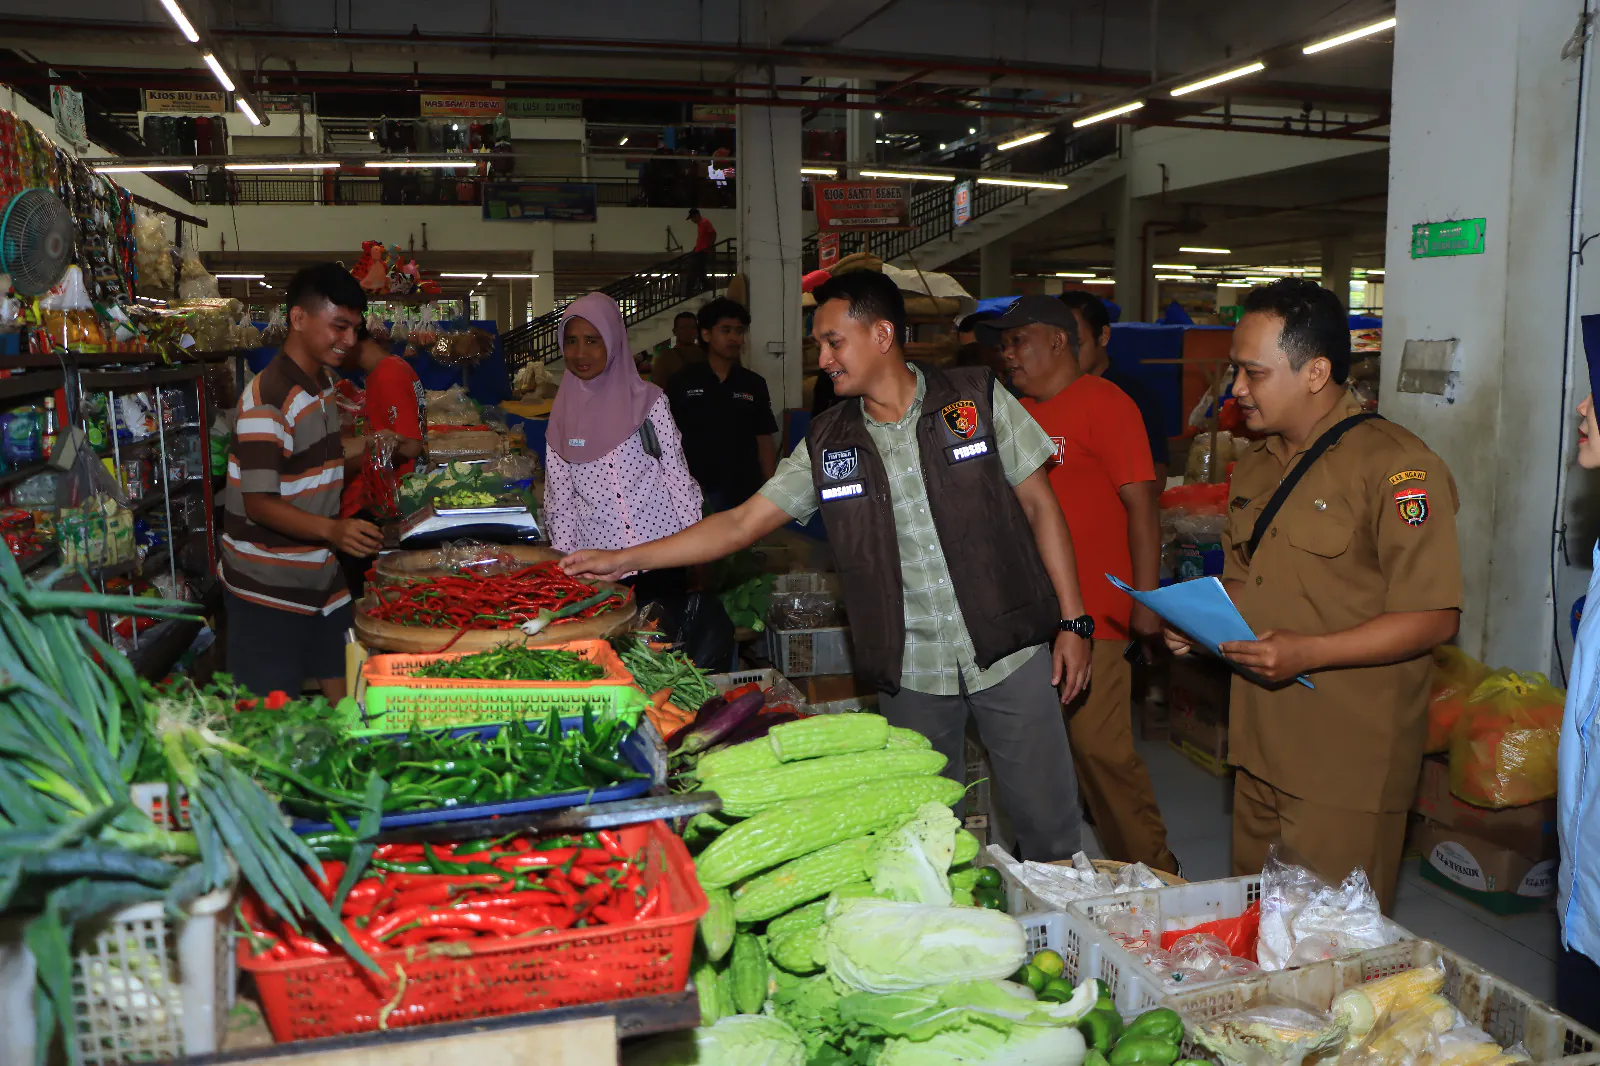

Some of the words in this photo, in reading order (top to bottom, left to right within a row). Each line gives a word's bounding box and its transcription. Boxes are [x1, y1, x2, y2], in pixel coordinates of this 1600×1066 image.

[149, 91, 176, 100] KIOS
[178, 92, 192, 100] BU
[823, 188, 844, 200] KIOS
[847, 187, 873, 200] SANTI
